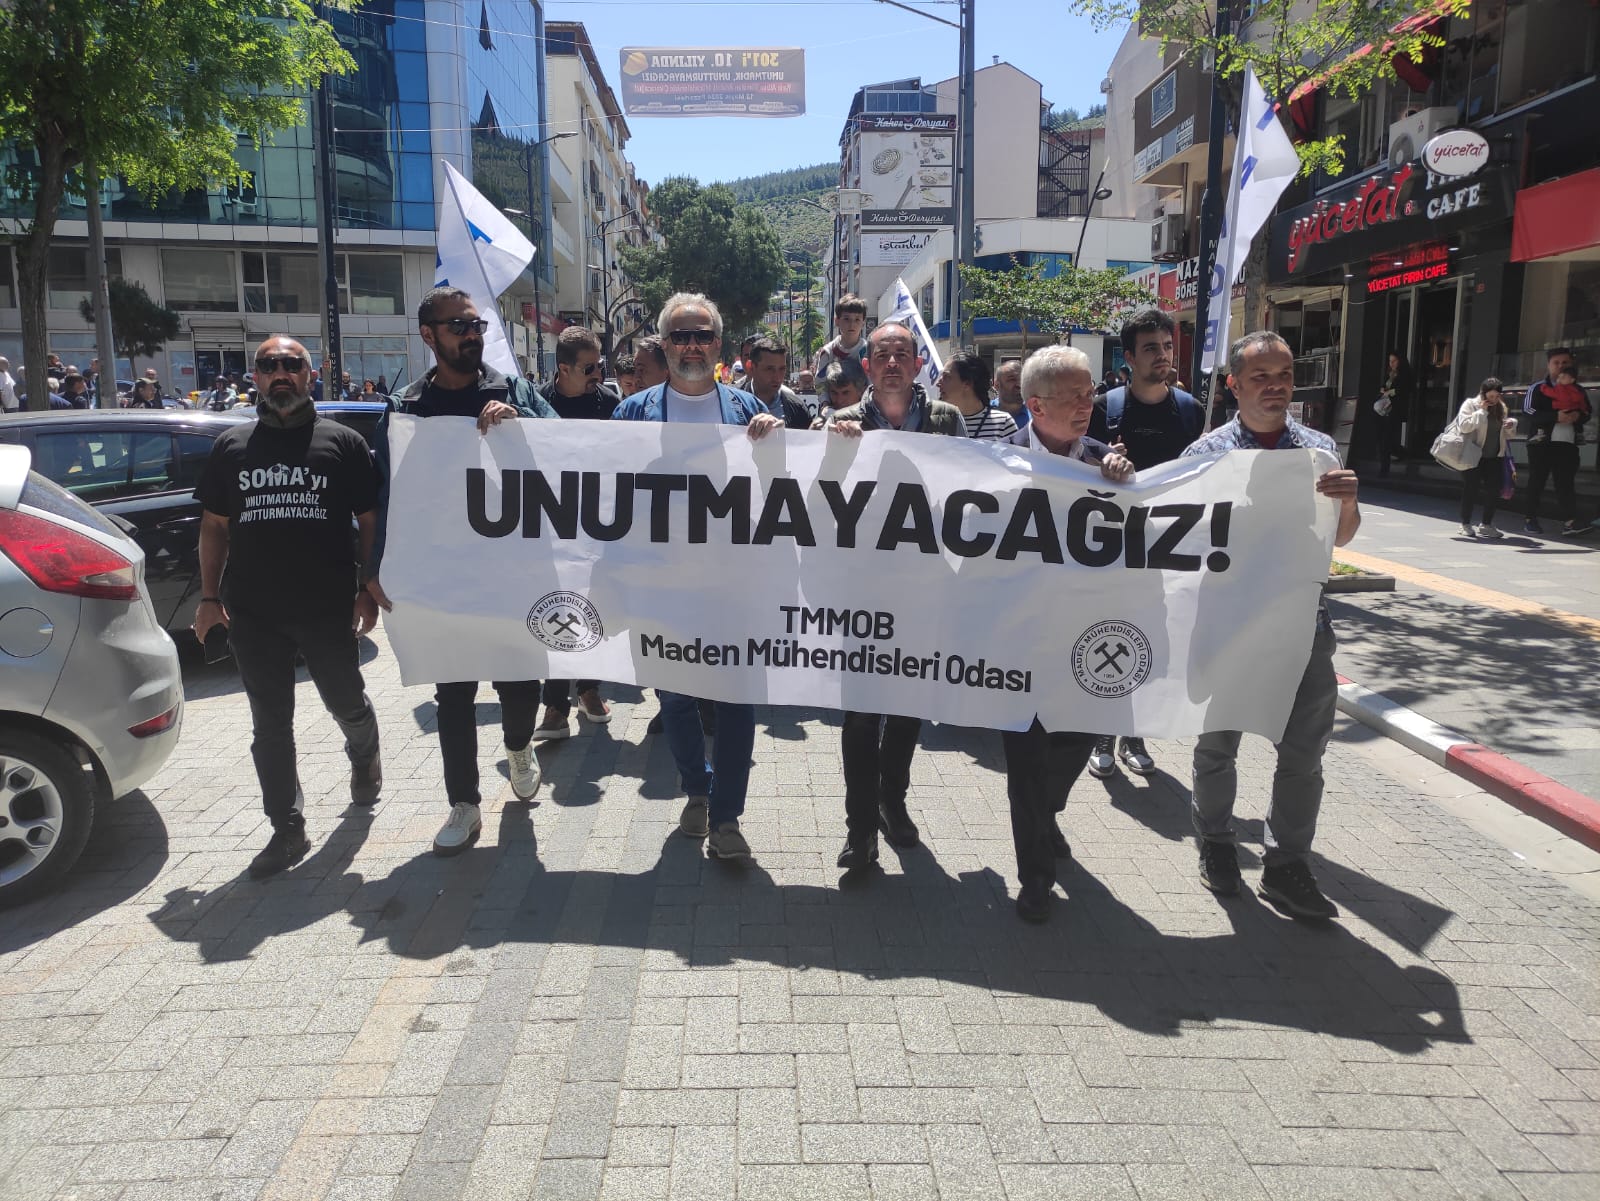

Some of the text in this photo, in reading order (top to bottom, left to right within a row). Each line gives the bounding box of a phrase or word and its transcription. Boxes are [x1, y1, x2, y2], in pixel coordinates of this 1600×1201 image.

[1433, 142, 1487, 164] yücetat
[1426, 183, 1481, 220] CAFE
[870, 213, 944, 223] Kahve Deryası
[1287, 164, 1413, 273] yücetat
[1367, 275, 1402, 293] YÜCETAT
[1424, 263, 1448, 280] CAFE
[239, 505, 328, 523] UNUTTURMAYACAĞIZ
[245, 490, 320, 508] UNUTMAYACAĞIZ
[466, 468, 1233, 573] UNUTMAYACAĞIZ!
[779, 605, 895, 640] TMMOB
[640, 633, 1032, 692] Maden Mühendisleri Odası
[1076, 644, 1086, 677] MADEN
[1090, 681, 1126, 694] TMMOB
